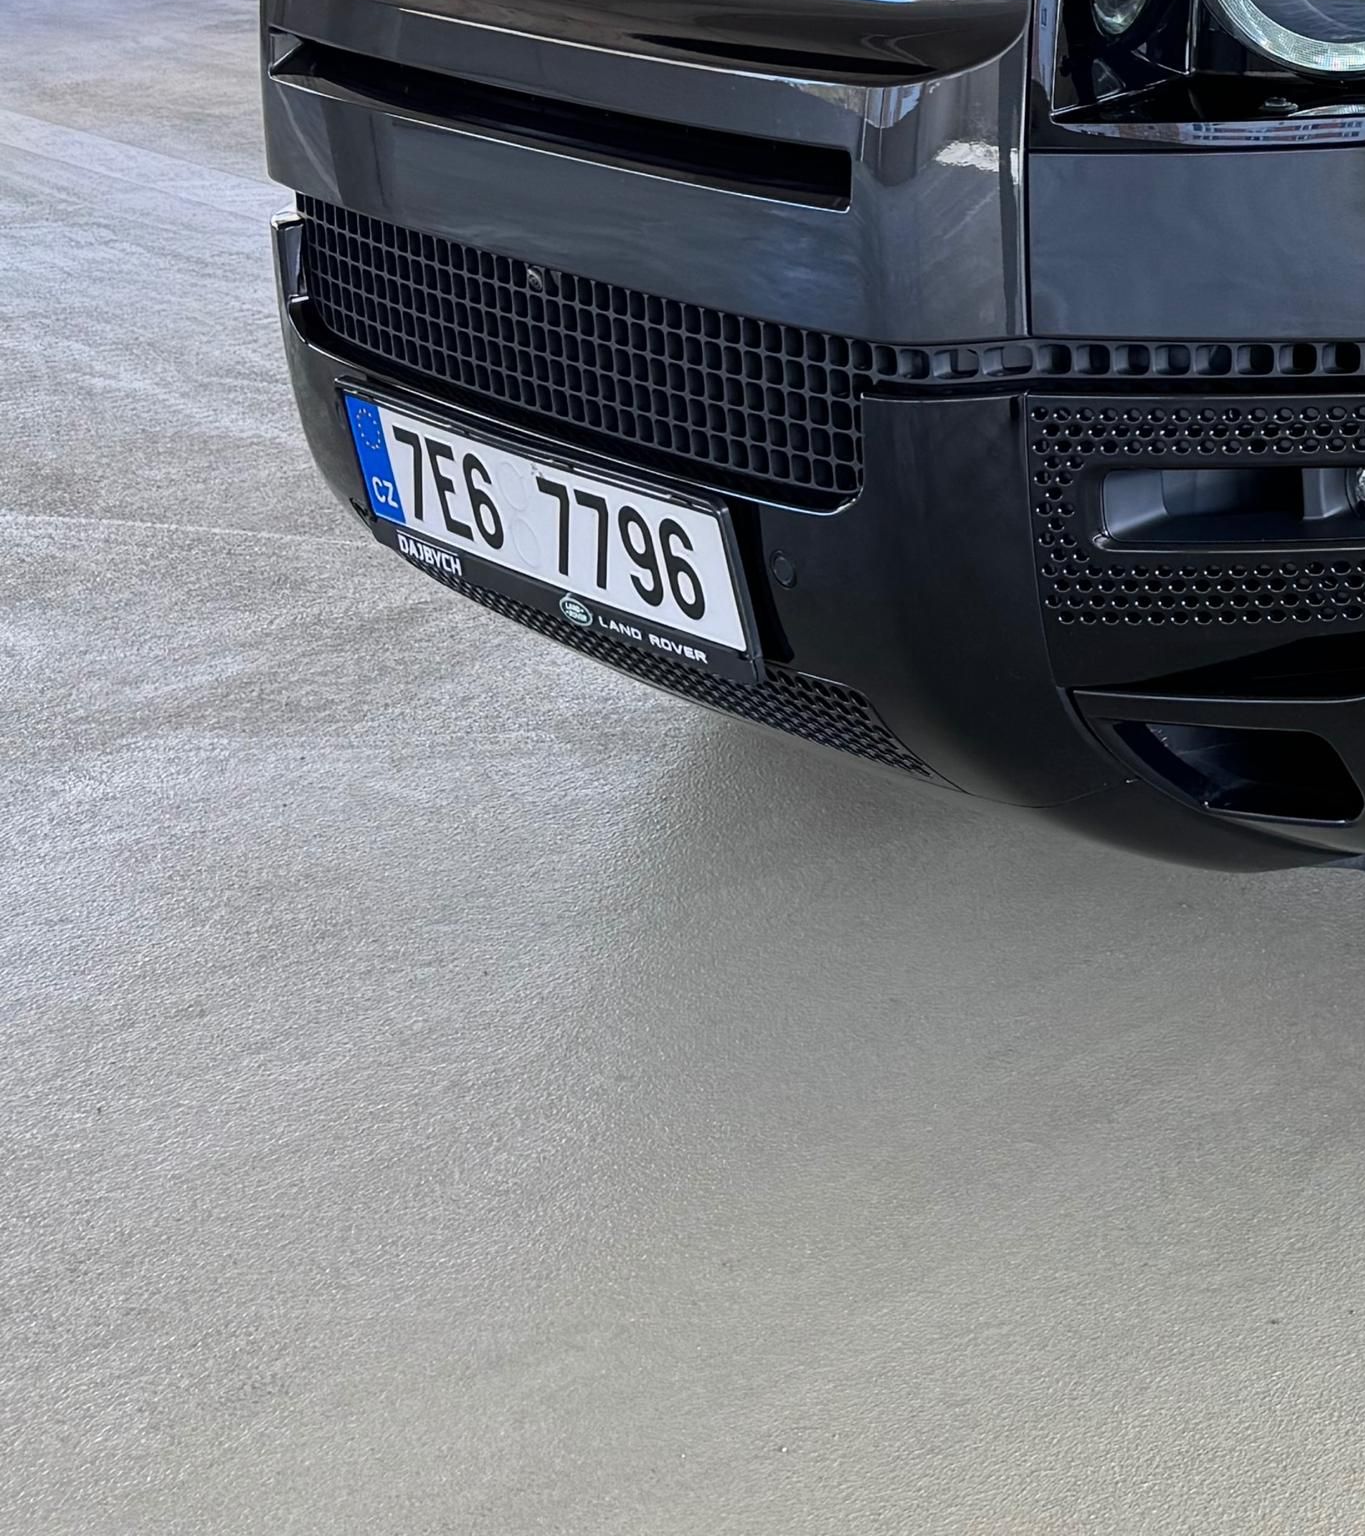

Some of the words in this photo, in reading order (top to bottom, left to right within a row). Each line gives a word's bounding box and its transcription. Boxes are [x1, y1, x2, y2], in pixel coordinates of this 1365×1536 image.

[372, 476, 399, 509] CZ
[391, 424, 505, 551] 7E6
[535, 476, 706, 622] 7796
[397, 533, 463, 577] DAJBYCH
[598, 615, 642, 641] LAND
[649, 633, 708, 664] ROVER
